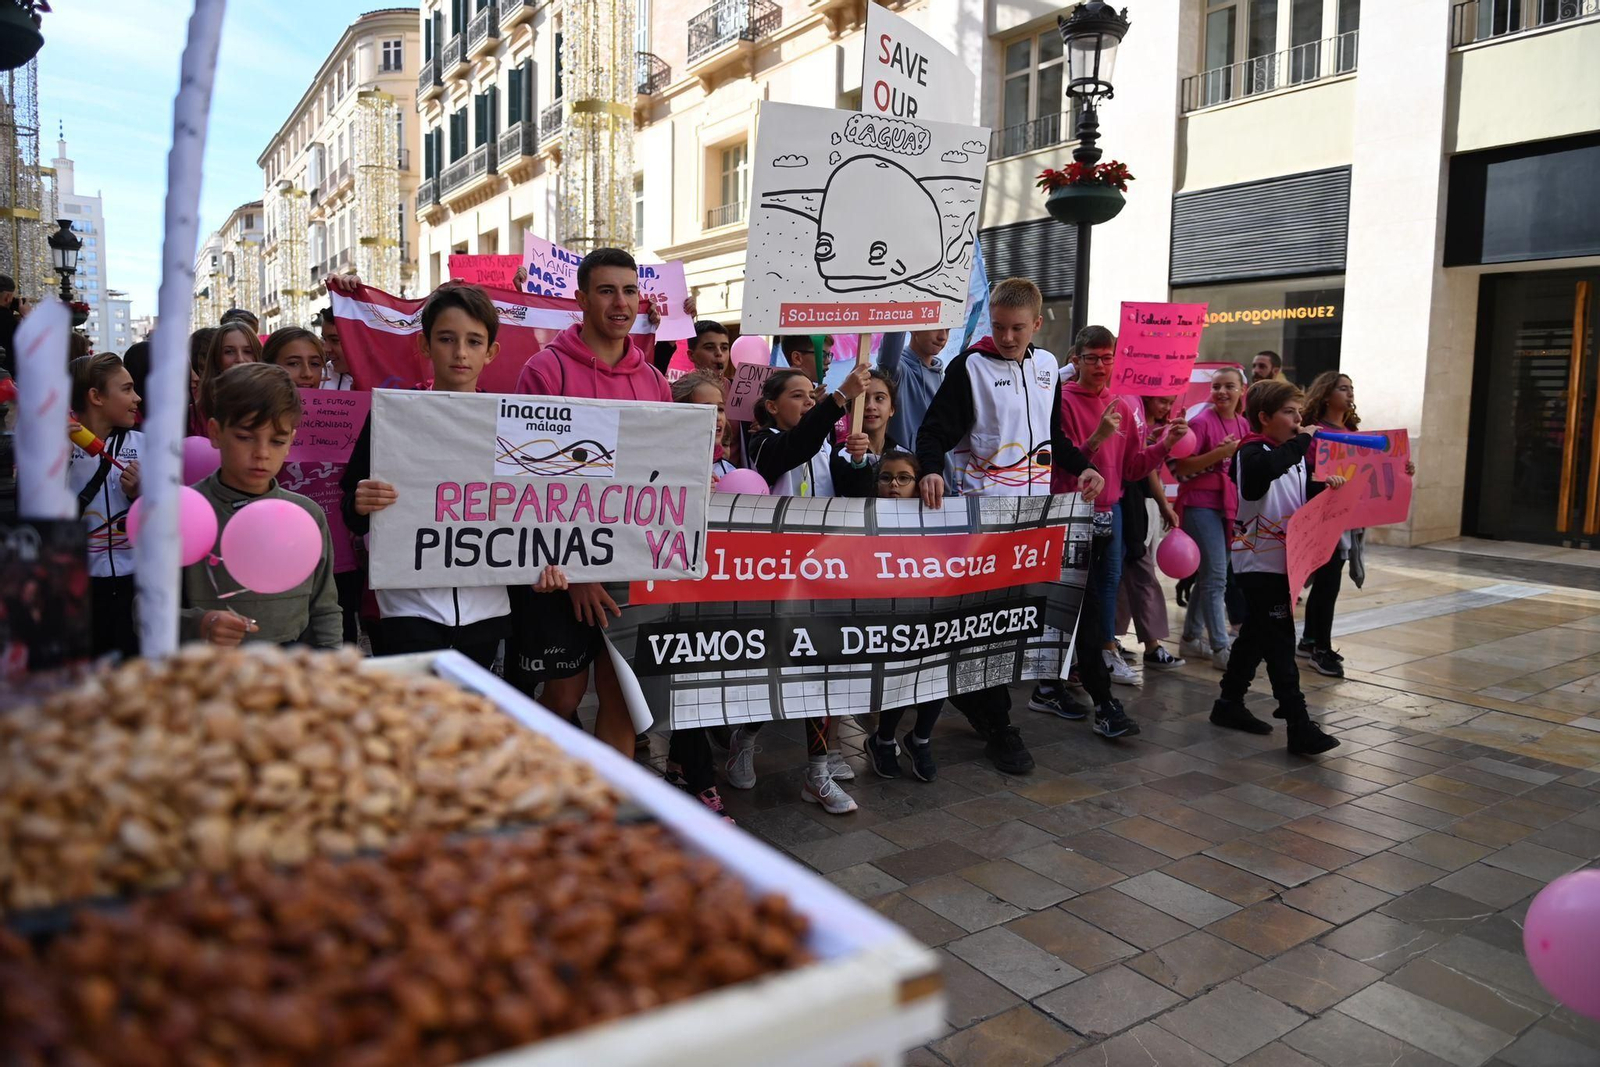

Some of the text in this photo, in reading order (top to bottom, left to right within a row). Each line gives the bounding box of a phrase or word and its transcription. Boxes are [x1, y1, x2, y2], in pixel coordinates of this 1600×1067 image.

[878, 34, 928, 87] SAVE
[873, 80, 918, 119] OUR
[849, 119, 927, 150] ¡AGUA!
[780, 305, 940, 325] ¡Solución Inacua Ya!
[1203, 305, 1335, 326] ADOLFODOMINGUEZ
[735, 381, 751, 395] ES
[994, 378, 1011, 388] vive
[312, 398, 322, 406] EL
[326, 398, 356, 407] FUTURO
[500, 398, 572, 421] inacua
[525, 421, 571, 435] málaga
[434, 470, 687, 527] REPARACIÓN
[414, 526, 614, 571] PISCINAS
[645, 529, 700, 571] YA!
[873, 552, 997, 579] Inacua
[1012, 540, 1051, 570] Ya!
[648, 606, 1039, 665] VAMOS A DESAPARECER
[543, 646, 567, 655] vive
